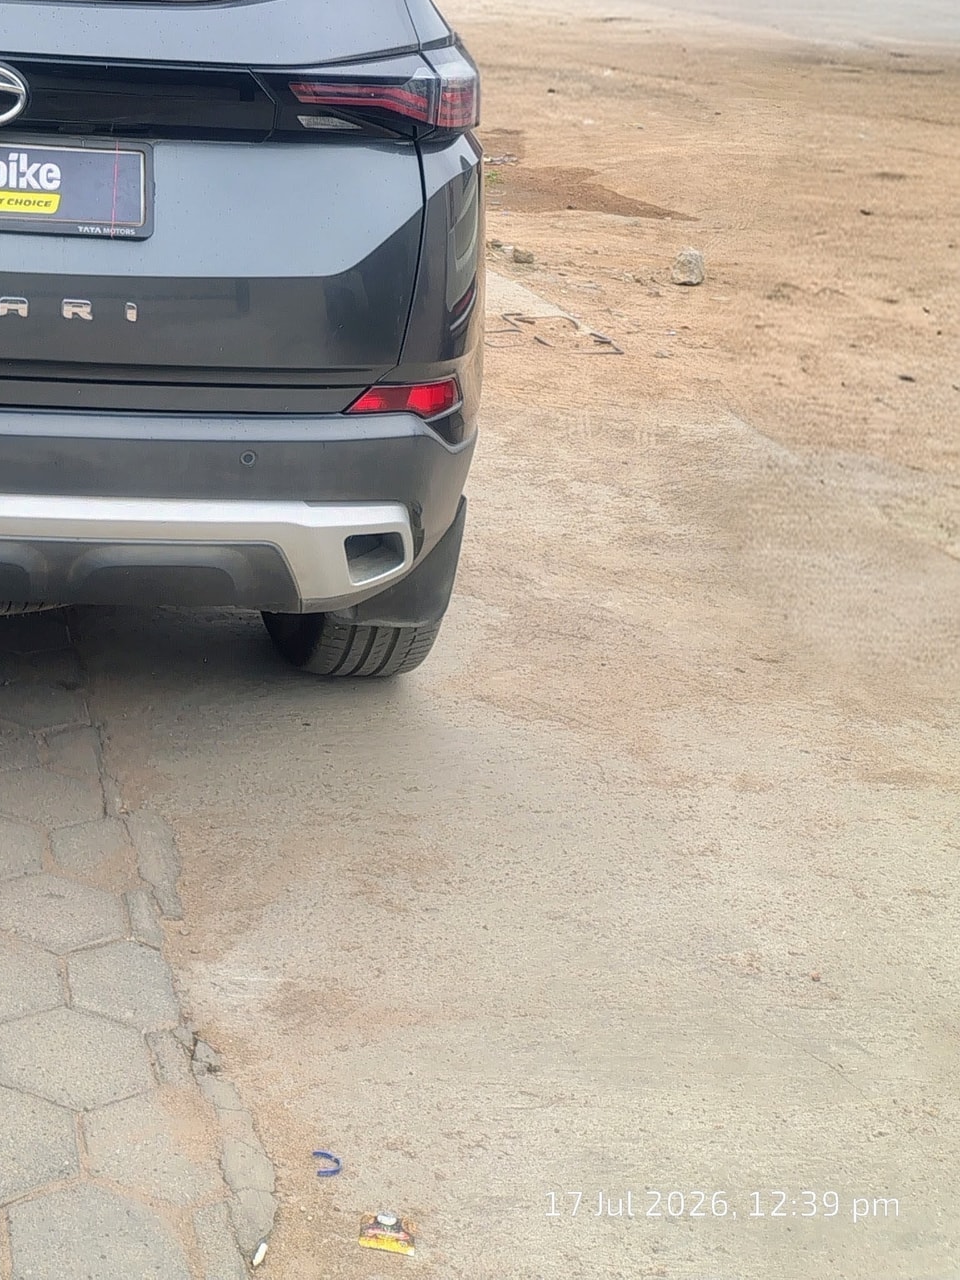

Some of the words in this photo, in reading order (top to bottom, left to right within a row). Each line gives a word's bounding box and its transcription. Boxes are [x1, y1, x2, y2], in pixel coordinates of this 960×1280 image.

[6, 198, 53, 208] CHOICE
[77, 225, 101, 234] TATA
[102, 227, 136, 235] MOTORS
